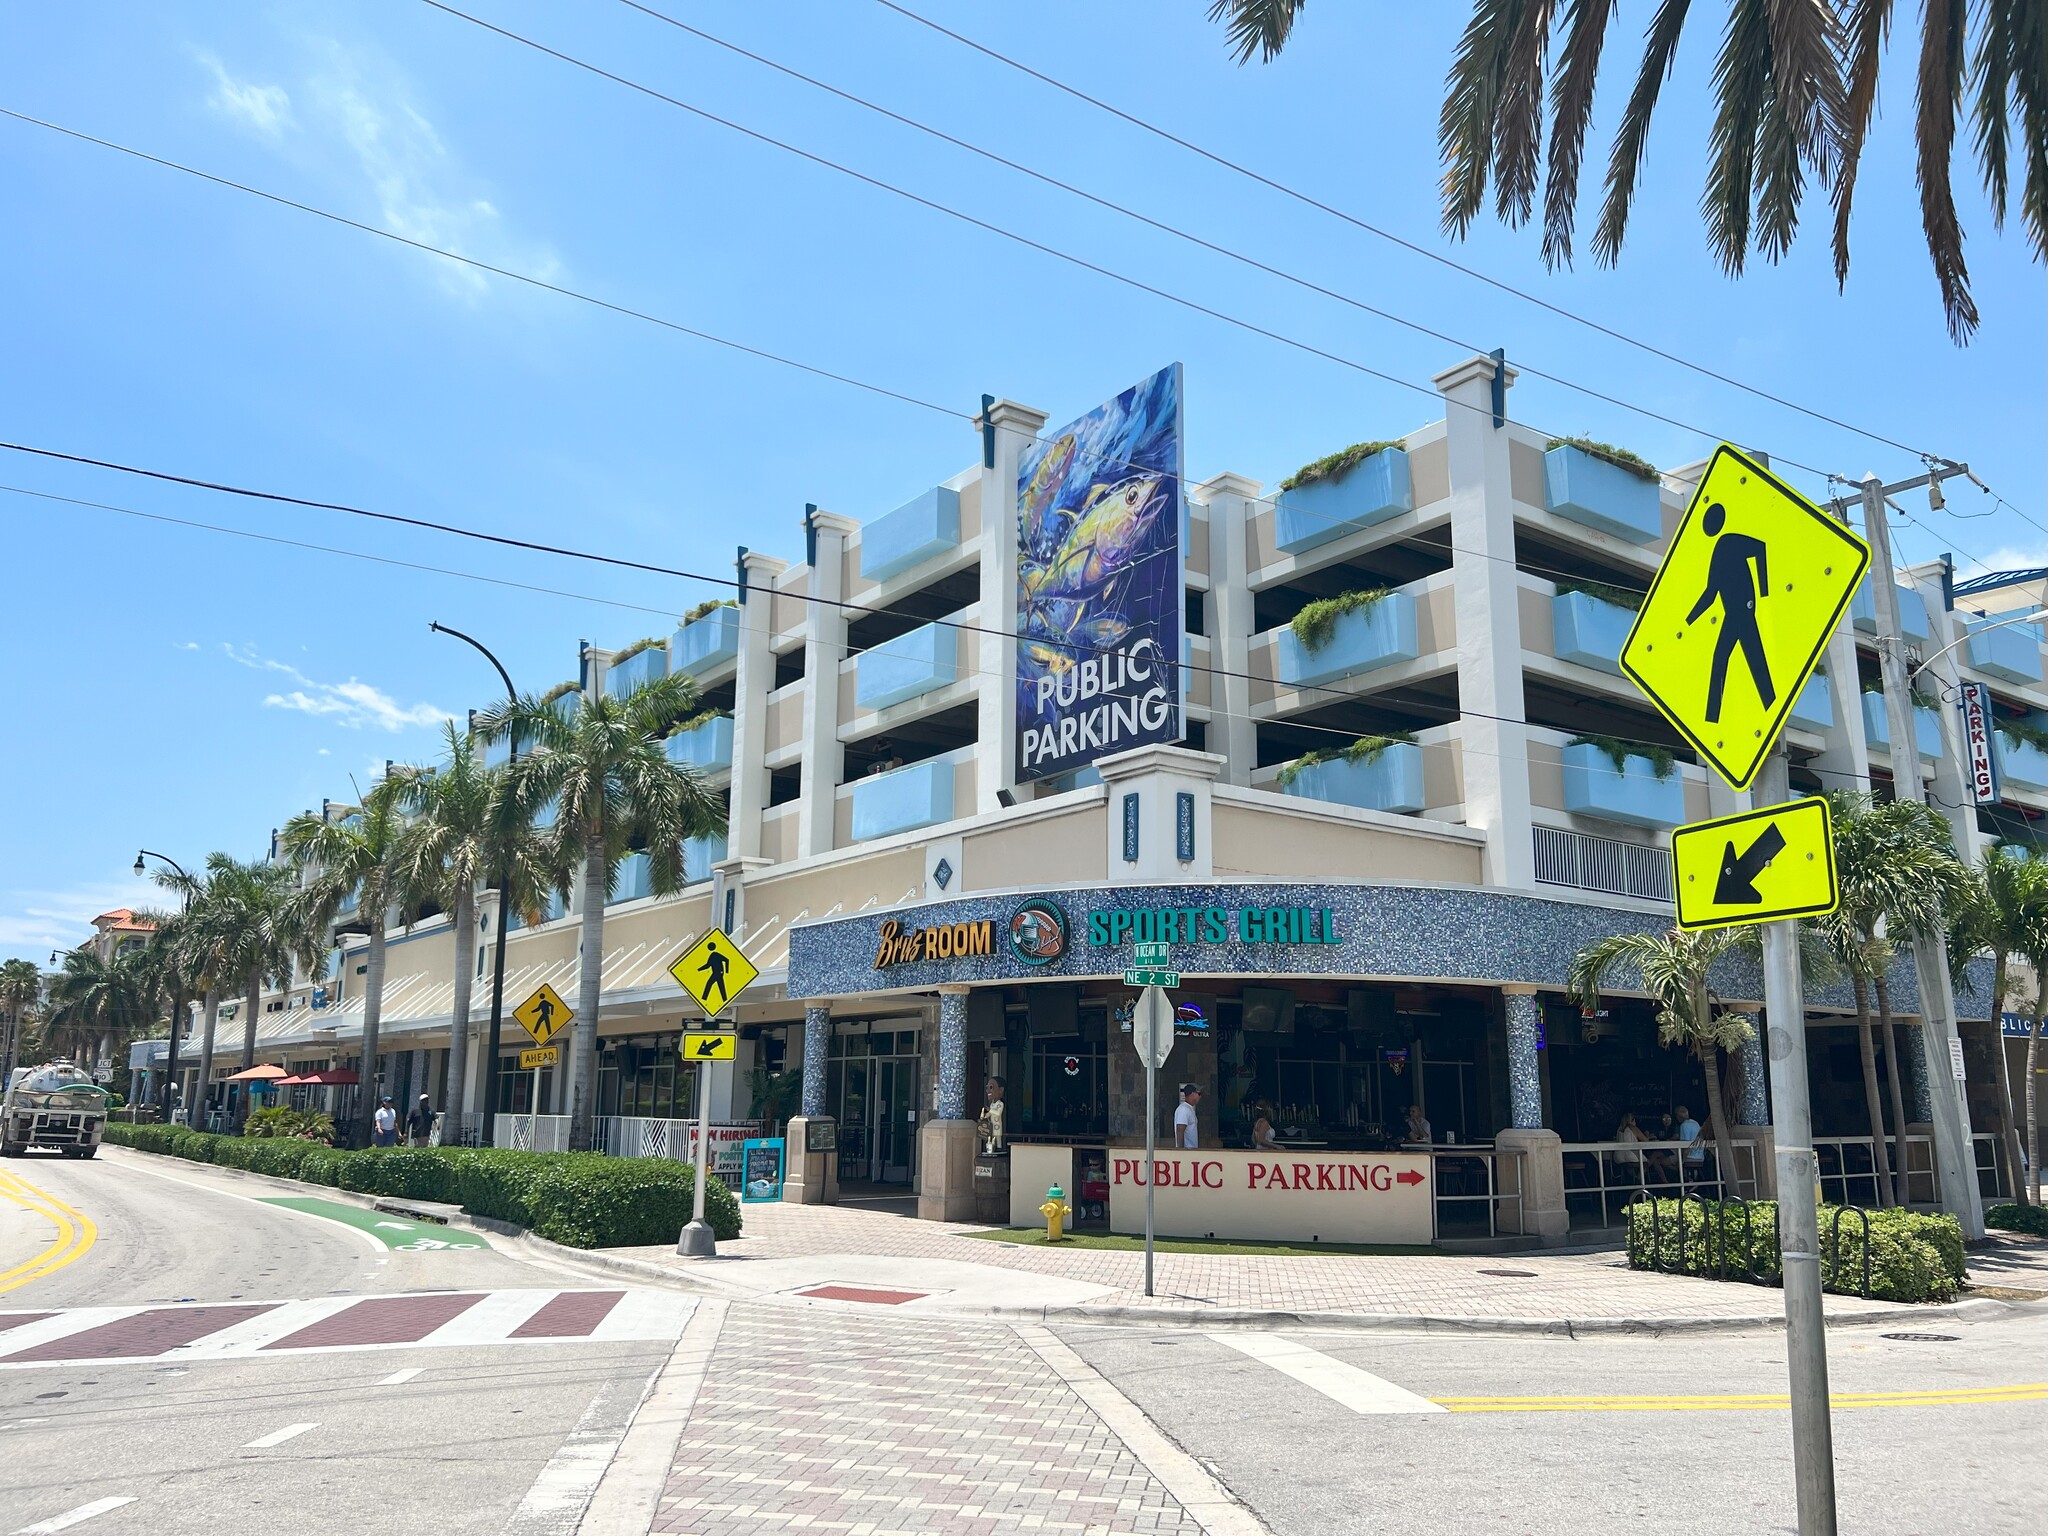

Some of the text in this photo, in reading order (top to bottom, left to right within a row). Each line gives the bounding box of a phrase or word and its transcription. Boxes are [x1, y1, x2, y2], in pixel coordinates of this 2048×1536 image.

[1037, 638, 1152, 715] PUBLIC
[1022, 686, 1169, 768] PARKING
[1966, 688, 1990, 786] PARKING
[925, 920, 992, 960] ROOM
[1088, 907, 1228, 946] SPORTS
[1238, 906, 1343, 945] GRILL
[1140, 945, 1155, 957] OCEAN
[1158, 945, 1167, 956] DR
[1126, 971, 1177, 986] NE 2 ST
[2001, 1018, 2031, 1031] BLIC
[525, 1052, 554, 1063] AHEAD
[690, 1129, 759, 1141] NW HIRING
[1962, 1123, 1972, 1146] 2
[1113, 1158, 1392, 1192] PUBLIC PARKING
